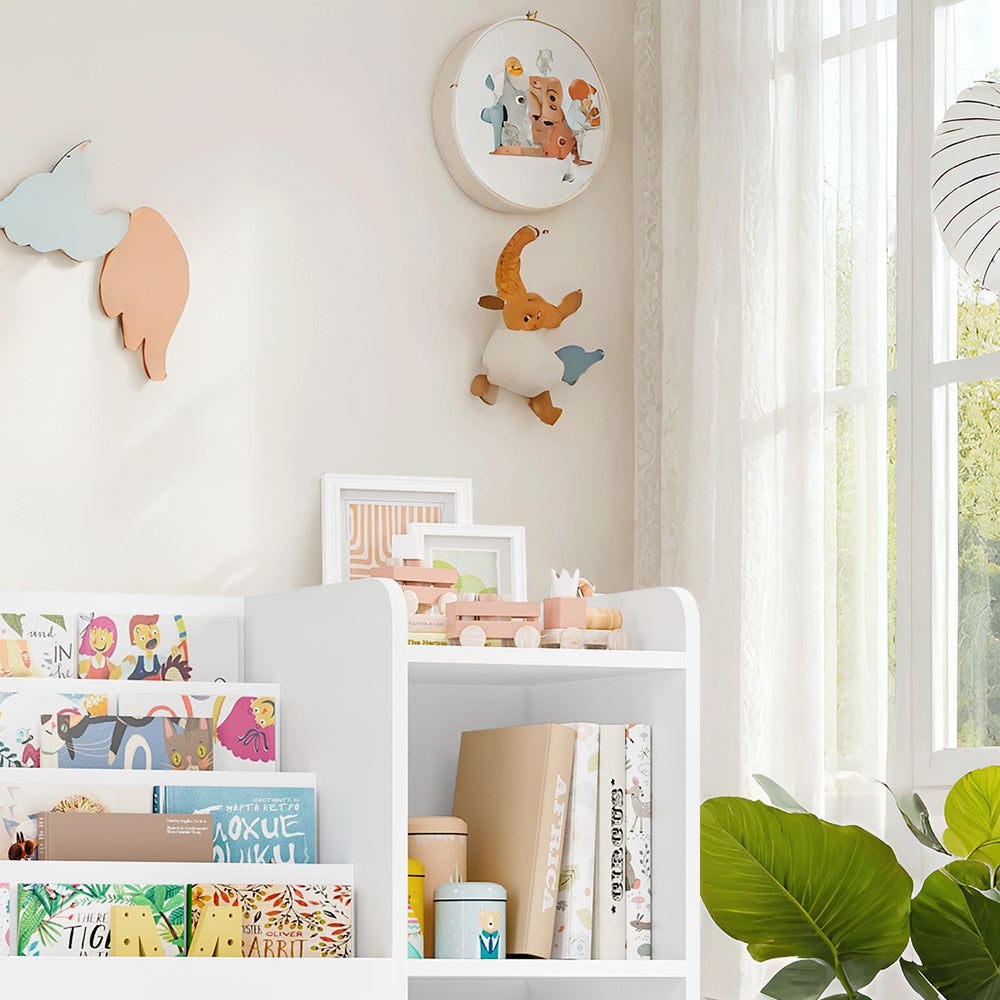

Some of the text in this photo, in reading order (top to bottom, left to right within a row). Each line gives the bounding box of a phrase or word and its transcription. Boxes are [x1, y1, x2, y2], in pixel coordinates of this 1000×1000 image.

[27, 626, 56, 638] und
[542, 774, 567, 913] AFRICA
[242, 936, 308, 957] ABBIT
